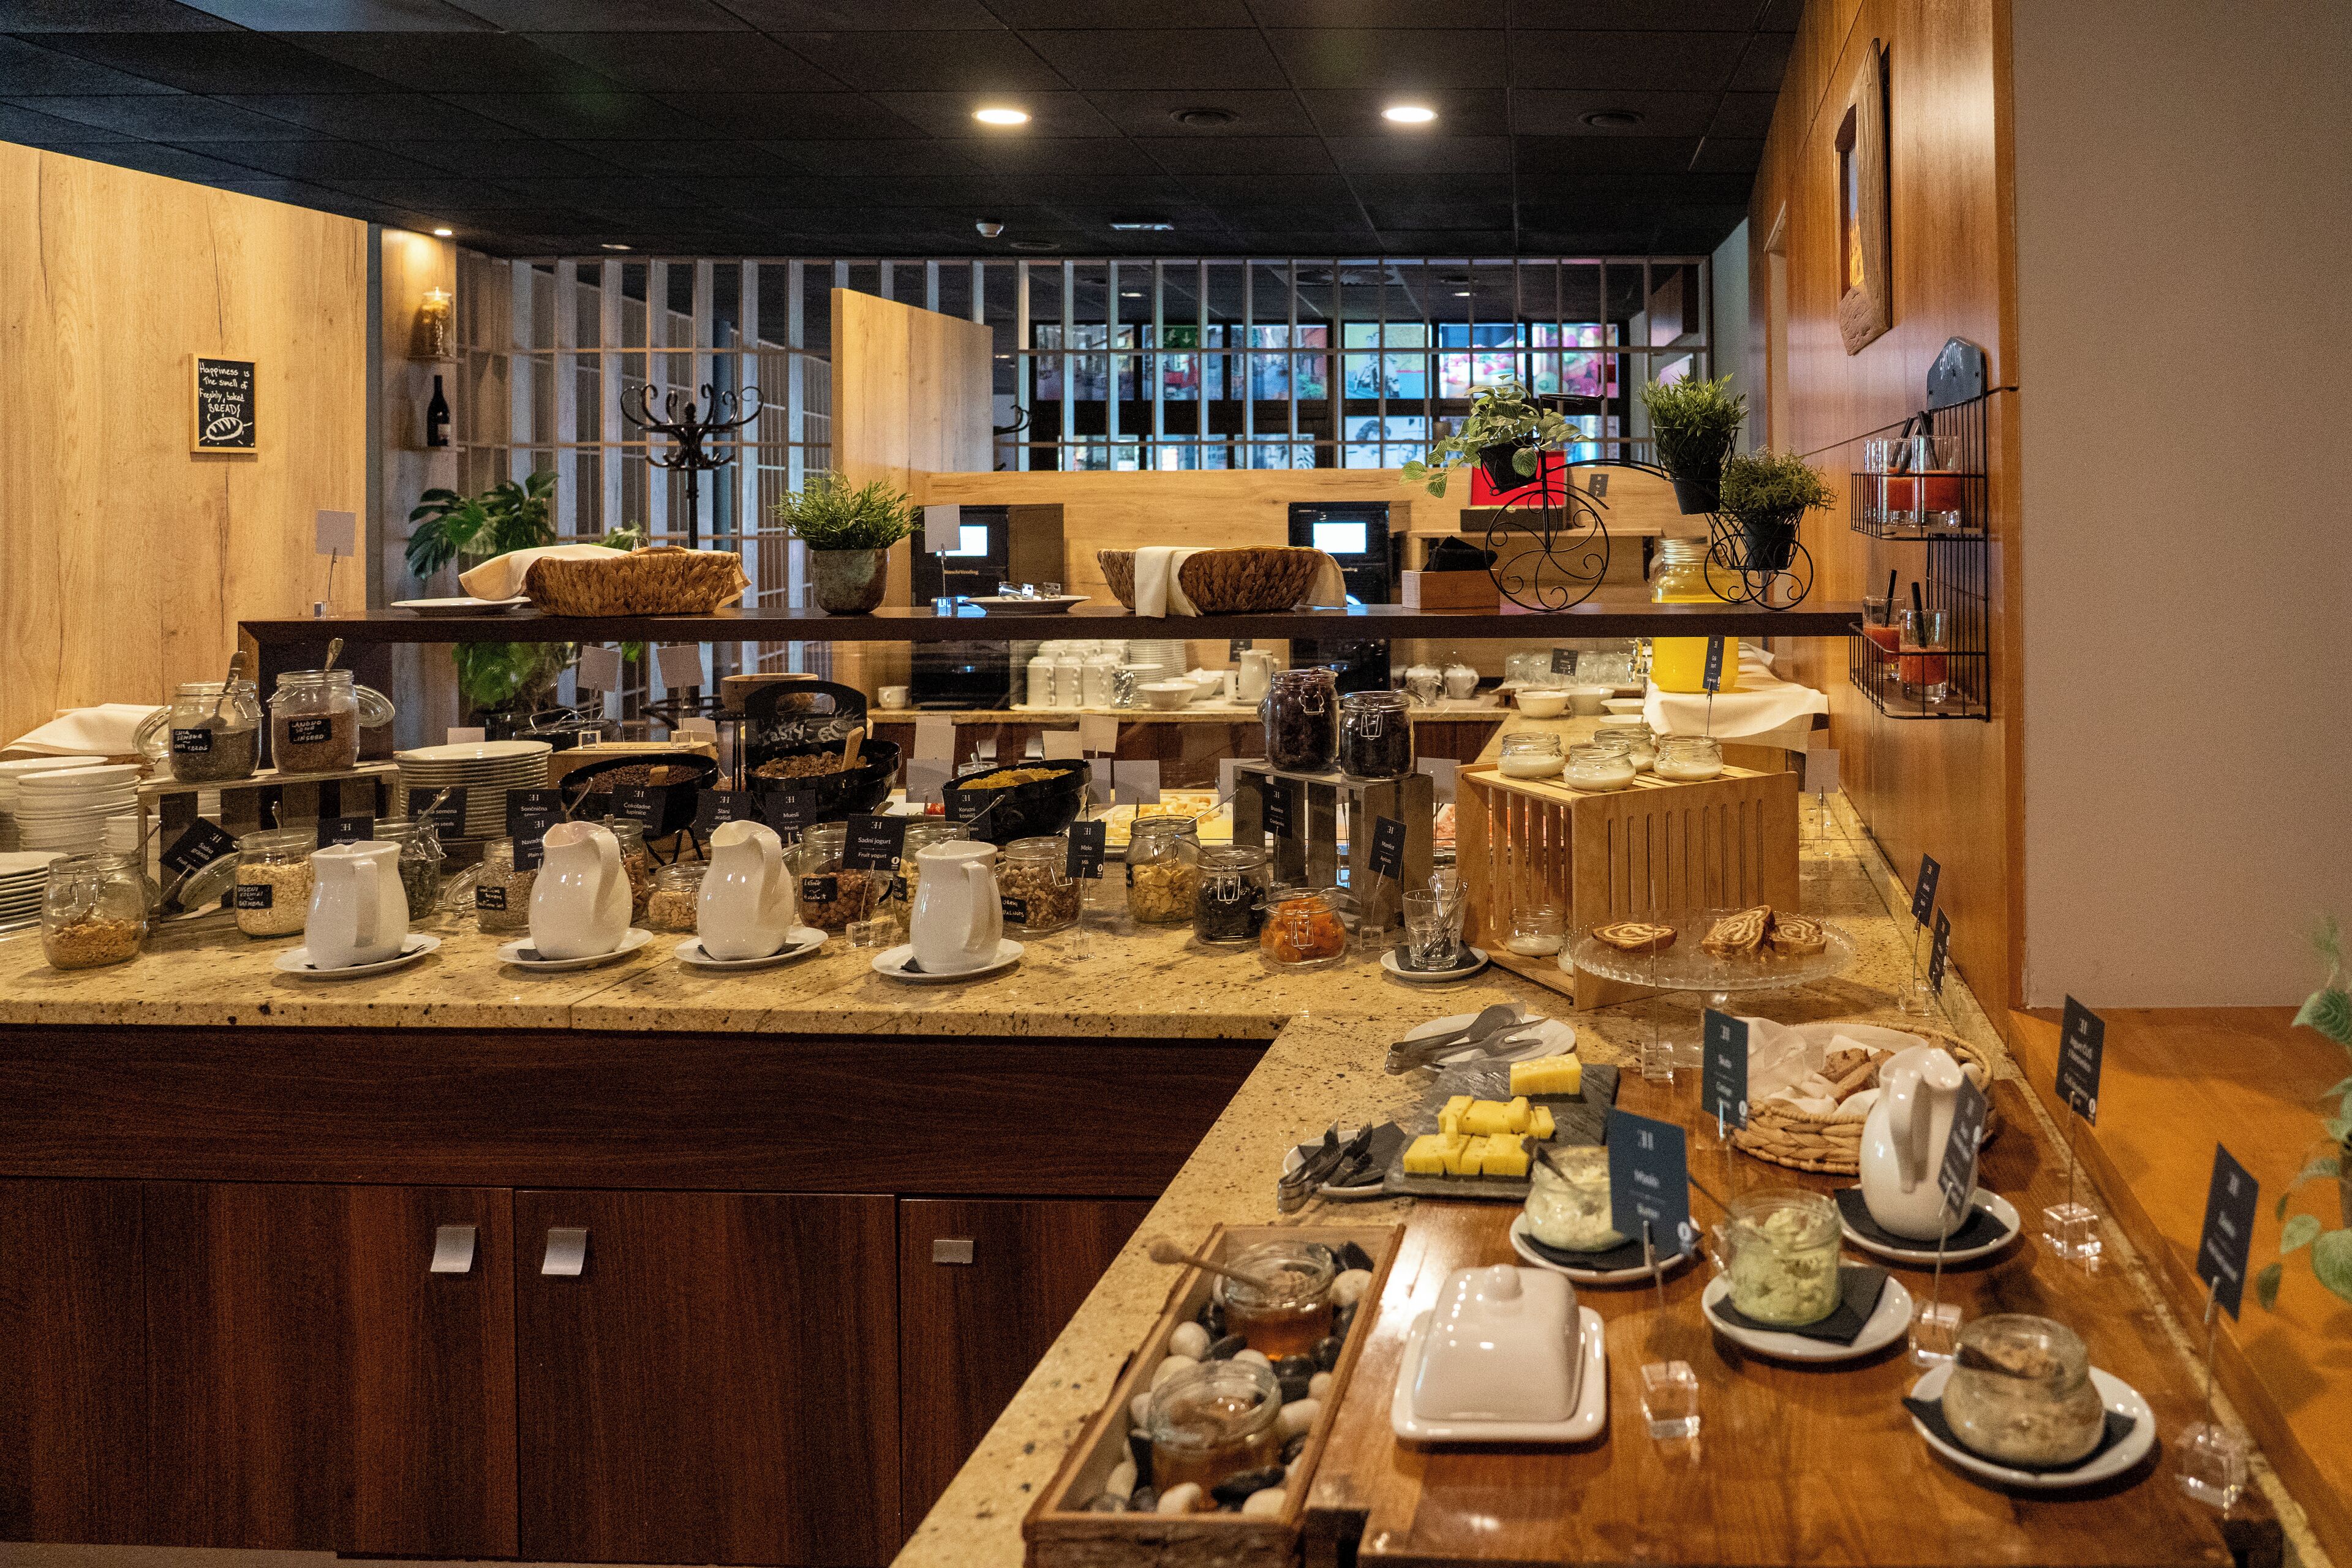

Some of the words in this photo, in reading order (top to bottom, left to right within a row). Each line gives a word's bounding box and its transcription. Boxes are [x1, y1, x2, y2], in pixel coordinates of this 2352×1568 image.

[199, 361, 239, 377] Happiness
[203, 377, 216, 385] The
[219, 378, 238, 388] smell
[199, 388, 222, 402] Freshly
[227, 391, 245, 402] baked
[208, 404, 237, 415] BREAD
[198, 842, 214, 854] Sadna
